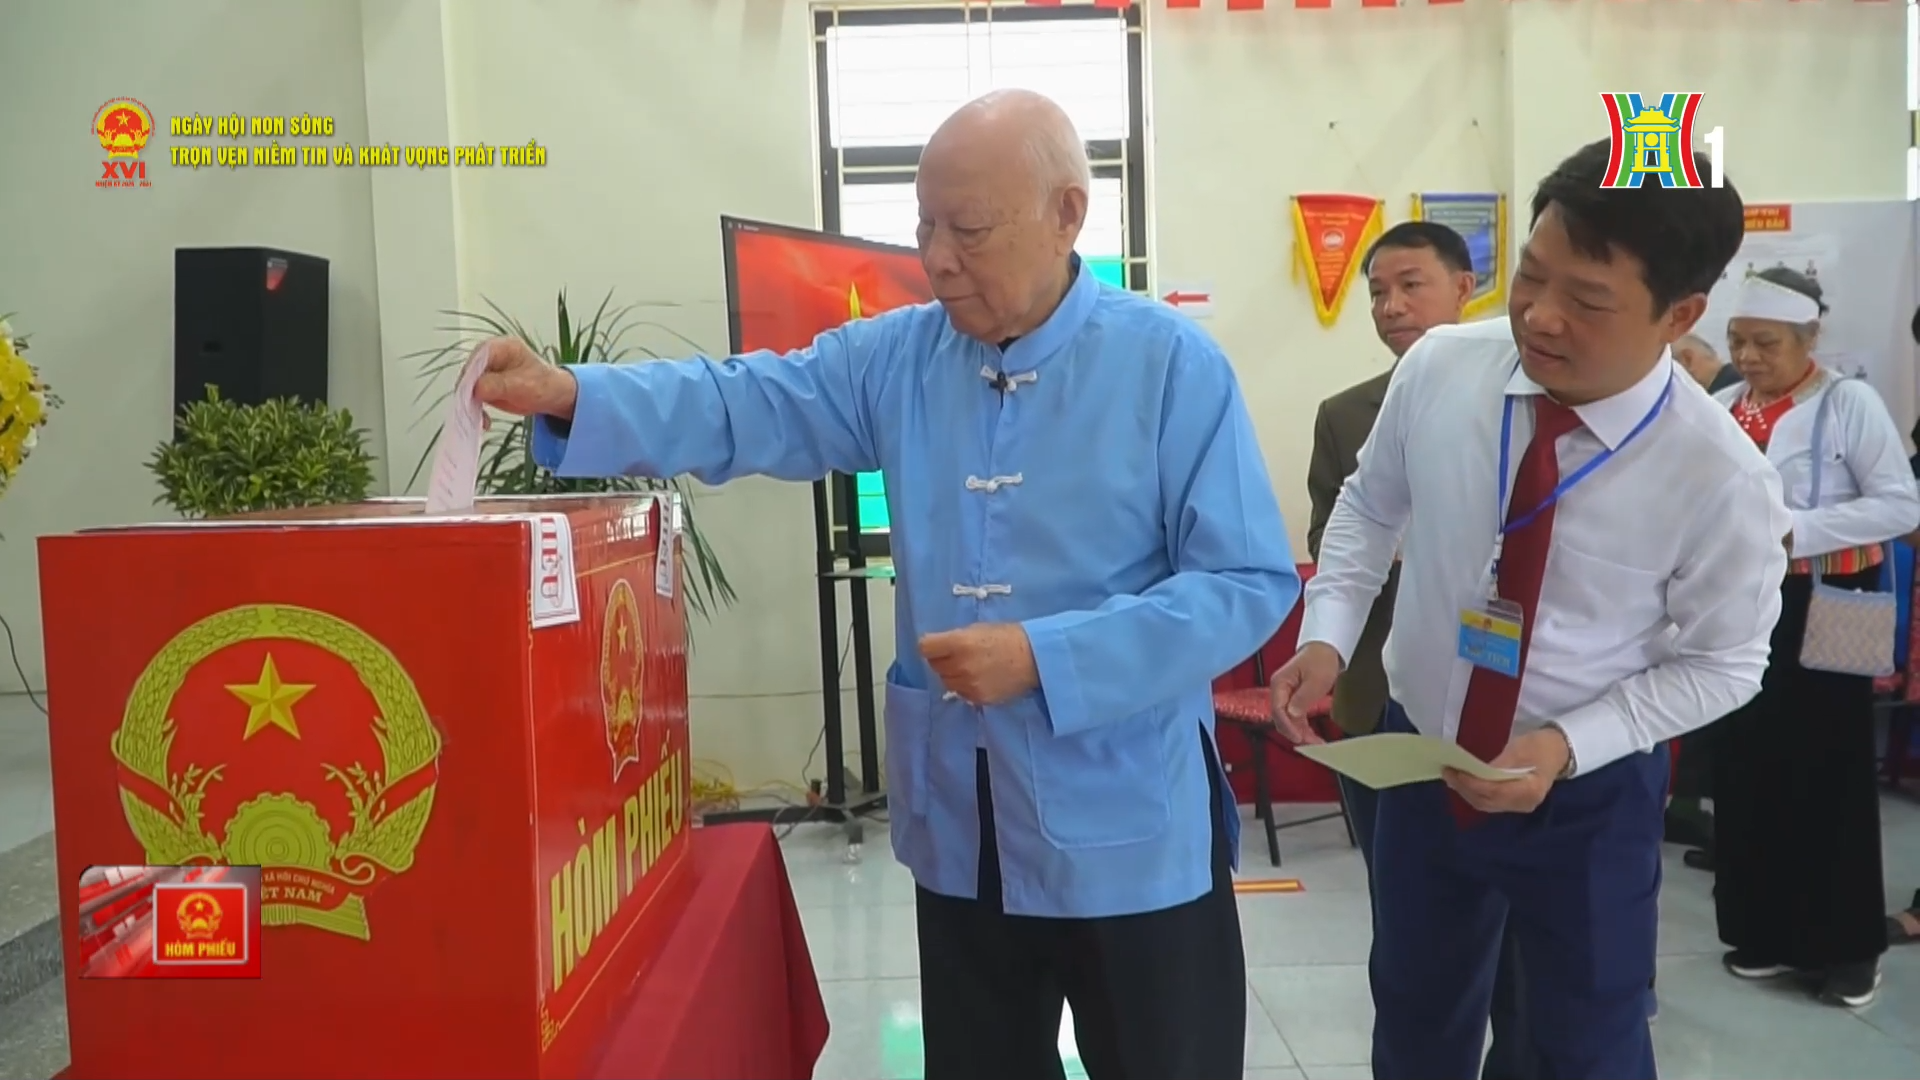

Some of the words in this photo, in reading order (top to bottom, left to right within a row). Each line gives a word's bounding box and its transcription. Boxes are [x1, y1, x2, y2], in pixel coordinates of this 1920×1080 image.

[284, 887, 322, 903] NAM
[551, 814, 618, 993] HÒM
[624, 729, 684, 897] PHIẾU
